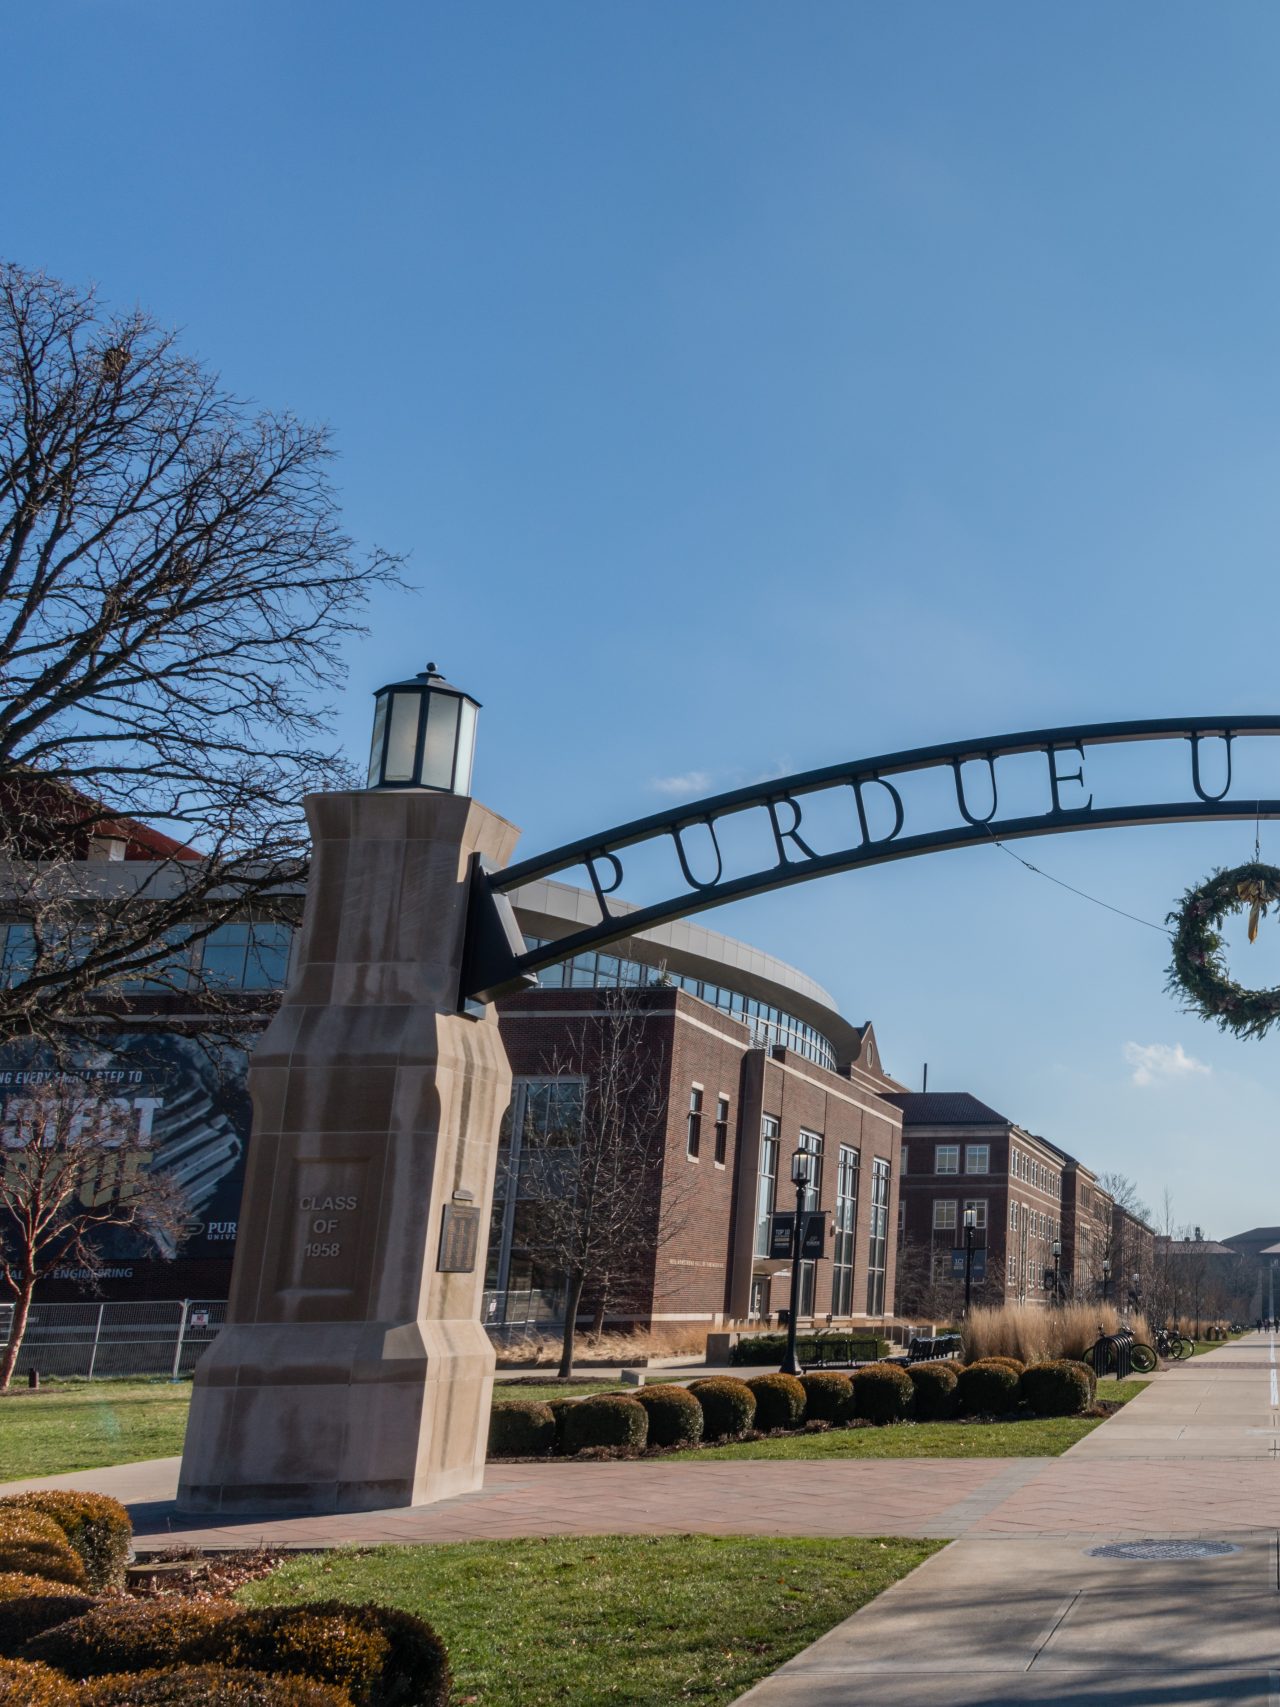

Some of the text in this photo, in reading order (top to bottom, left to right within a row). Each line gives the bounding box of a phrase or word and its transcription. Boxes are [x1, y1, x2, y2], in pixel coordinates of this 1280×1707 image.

[581, 740, 1093, 926] PURDUE
[15, 1071, 51, 1084] EVERY
[96, 1071, 124, 1083] STEP
[128, 1071, 143, 1083] TO
[300, 1196, 357, 1211] CLASS
[313, 1219, 338, 1234] OF
[304, 1242, 340, 1257] 1958
